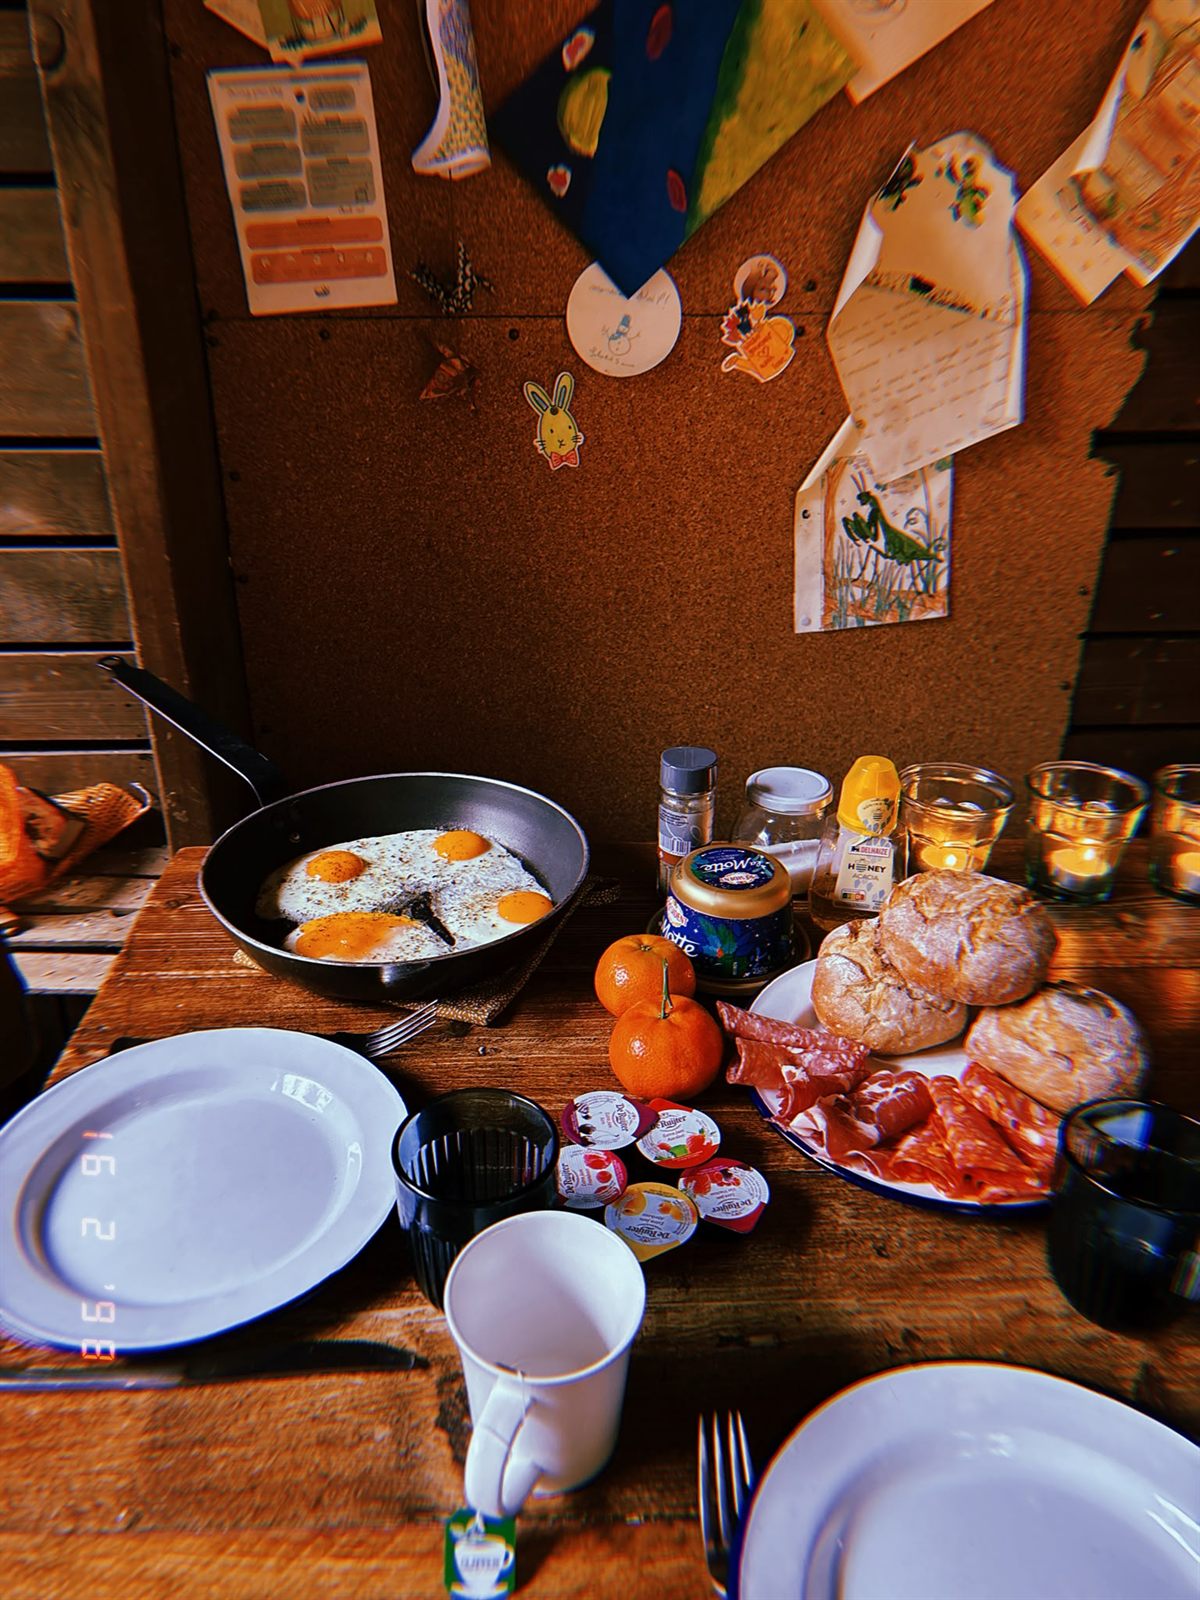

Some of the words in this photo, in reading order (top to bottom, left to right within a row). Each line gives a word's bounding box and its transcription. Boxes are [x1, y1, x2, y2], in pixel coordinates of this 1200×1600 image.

[860, 846, 888, 856] DELHAIZE
[700, 857, 751, 873] Motte
[852, 873, 880, 881] ACACIA
[615, 1103, 625, 1113] De
[660, 1115, 687, 1128] Ruijter
[561, 1162, 575, 1184] Ruijter
[564, 1183, 575, 1194] De
[711, 1202, 740, 1213] Ruijter
[740, 1199, 753, 1207] De
[625, 1225, 657, 1237] Ruijter
